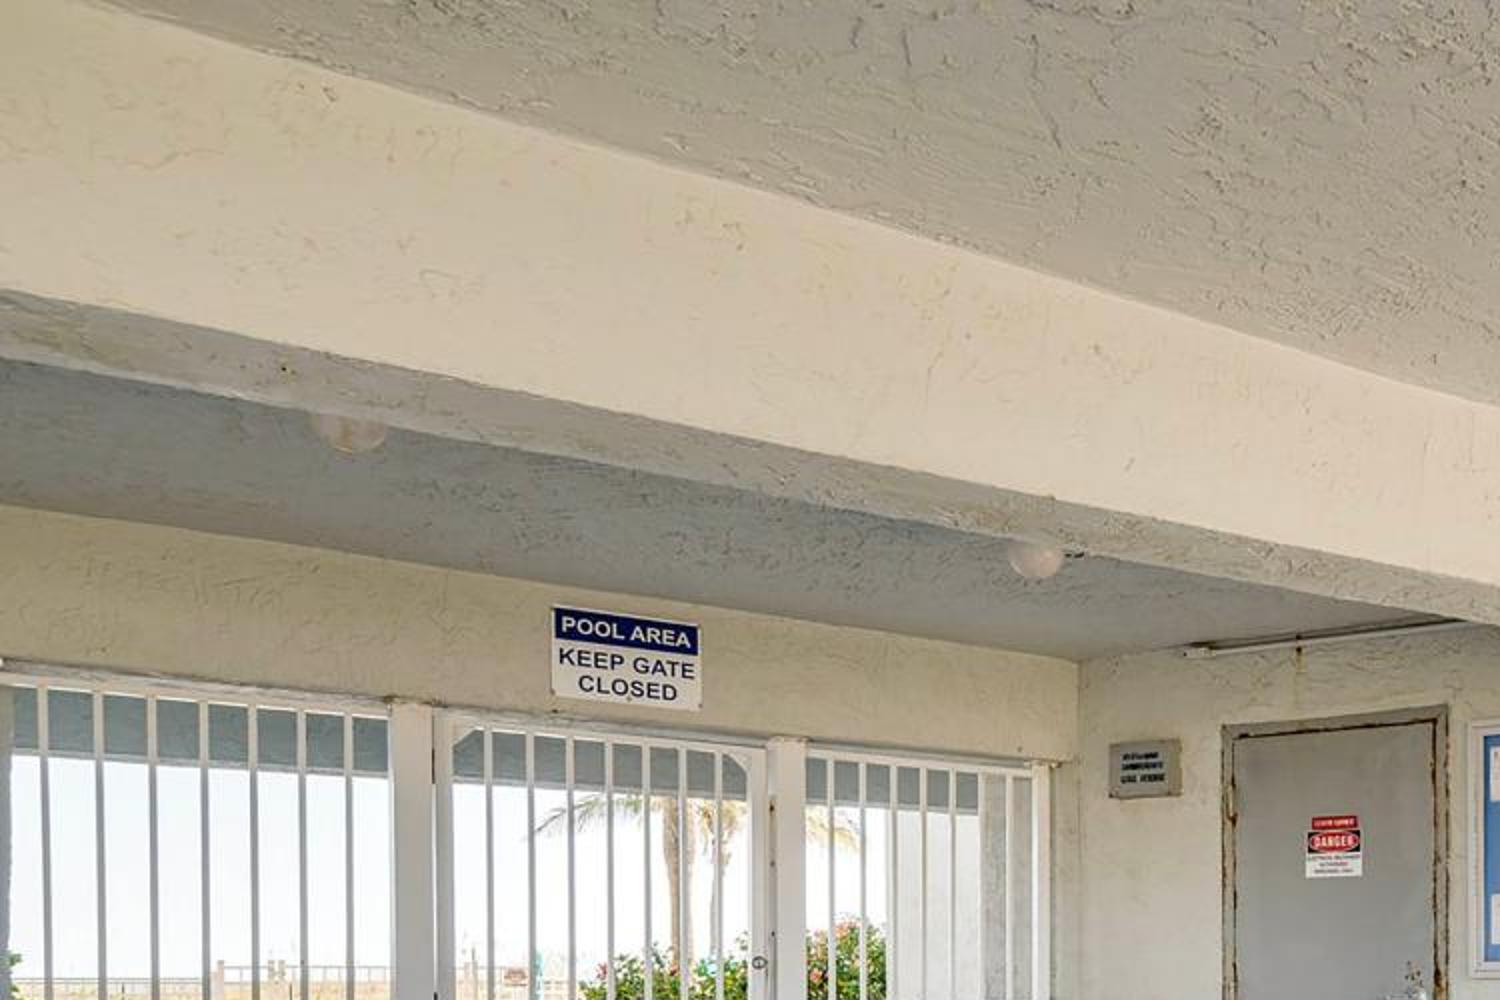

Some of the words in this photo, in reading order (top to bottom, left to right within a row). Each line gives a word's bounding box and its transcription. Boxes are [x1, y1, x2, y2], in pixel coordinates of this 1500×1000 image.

[561, 616, 625, 640] POOL
[630, 626, 691, 649] AREA
[559, 648, 625, 671] KEEP
[633, 657, 695, 680] GATE
[579, 675, 677, 701] CLOSED
[1313, 835, 1355, 847] DANGER
